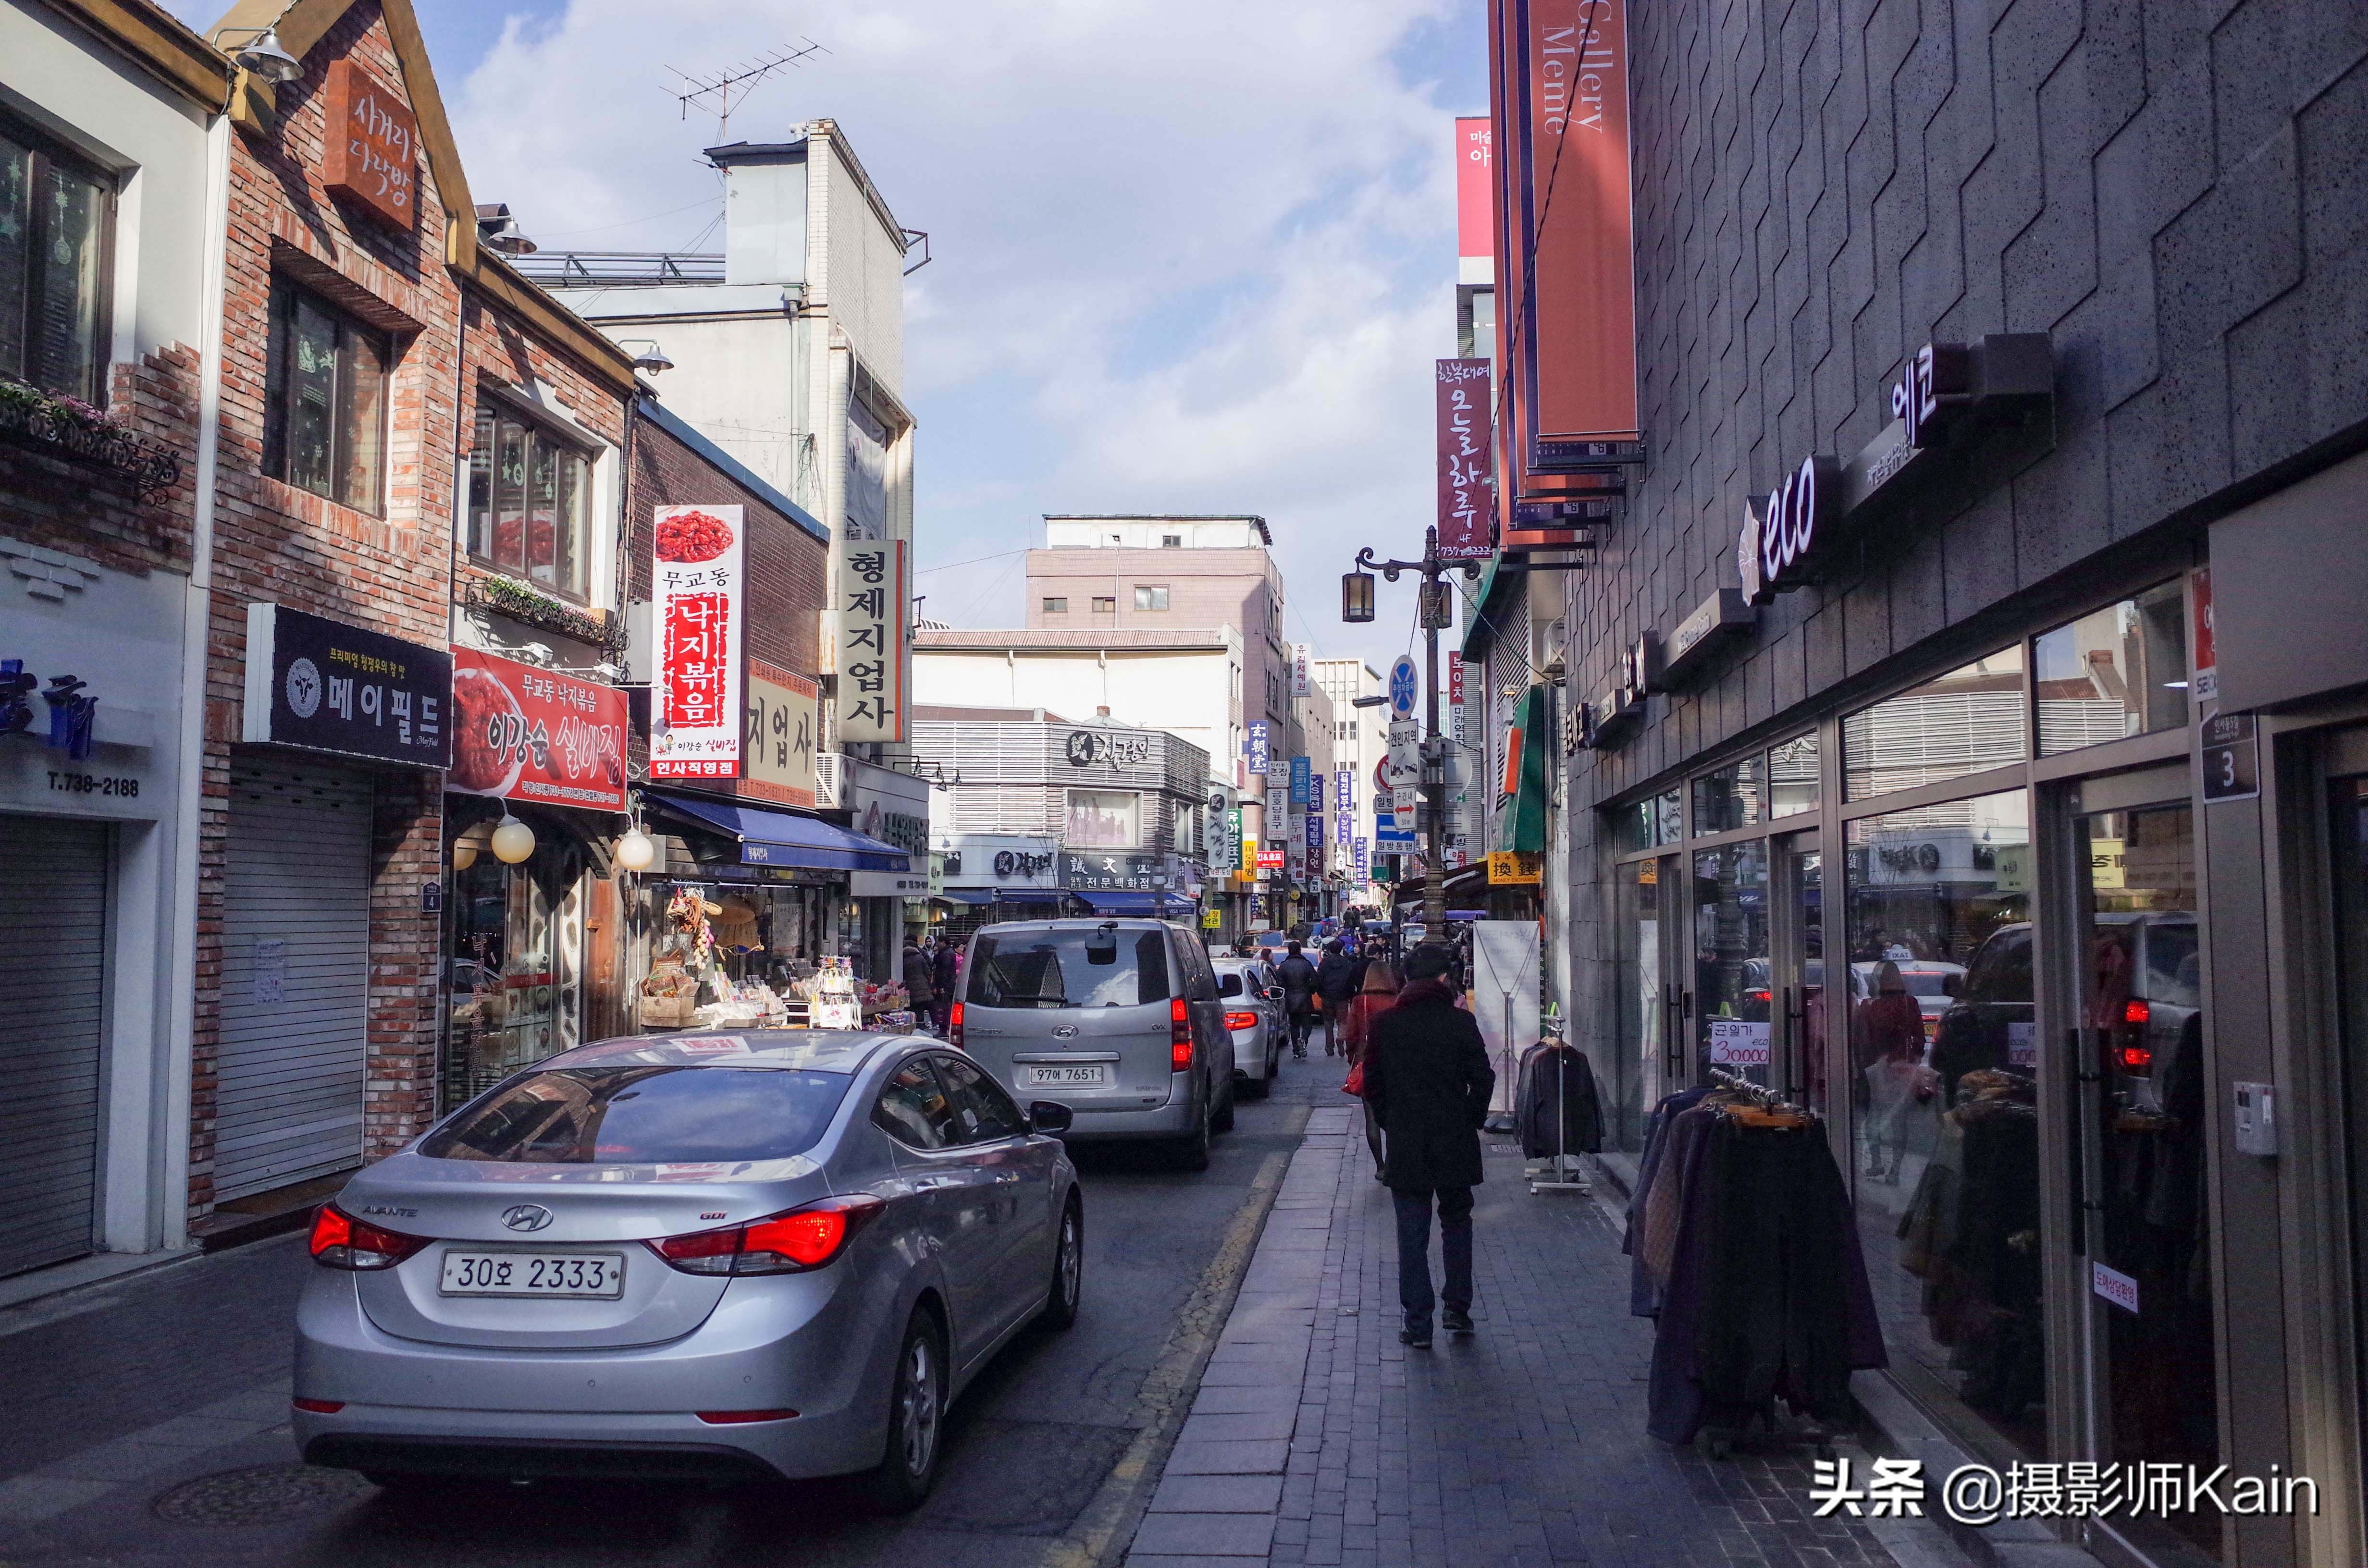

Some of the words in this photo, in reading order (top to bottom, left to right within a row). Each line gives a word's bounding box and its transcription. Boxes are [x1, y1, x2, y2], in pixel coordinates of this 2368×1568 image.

[1542, 24, 1574, 135] Meme
[355, 95, 408, 162] 사거리
[350, 138, 411, 206] 다락방
[1438, 362, 1490, 384] 한복대여
[1892, 342, 1936, 448] 에코
[1763, 456, 1814, 581] eco
[662, 567, 730, 589] 무교동
[847, 551, 894, 729] 형제지업사
[678, 600, 716, 721] 낙지볶음
[1297, 645, 1306, 690] 유림서예원
[522, 674, 555, 703] 무교동
[557, 684, 597, 713] 낙지볶음
[329, 675, 438, 745] 메이필드
[488, 711, 549, 770] 이강순
[556, 716, 622, 785] 실비집
[678, 741, 702, 752] 이강순
[706, 739, 736, 752] 실비집
[1391, 729, 1417, 747] 견인지역
[656, 761, 733, 775] 인사직영점
[1269, 768, 1287, 776] 큰집
[2222, 750, 2234, 787] 3
[48, 771, 139, 797] T.738-2188
[1396, 791, 1413, 801] 구간내
[1272, 790, 1283, 829] 금호당표구
[1290, 822, 1302, 845] 두레
[1378, 842, 1412, 851] 일방통행
[1310, 849, 1320, 869] 상원
[1086, 877, 1149, 889] 전문백화점
[429, 896, 434, 908] 4
[1714, 1025, 1752, 1037] 균일가
[1037, 1069, 1060, 1080] 97어
[1066, 1069, 1095, 1080] 7651
[362, 1205, 418, 1217] AVANTE
[457, 1259, 512, 1286] 30호
[528, 1259, 604, 1288] 2333
